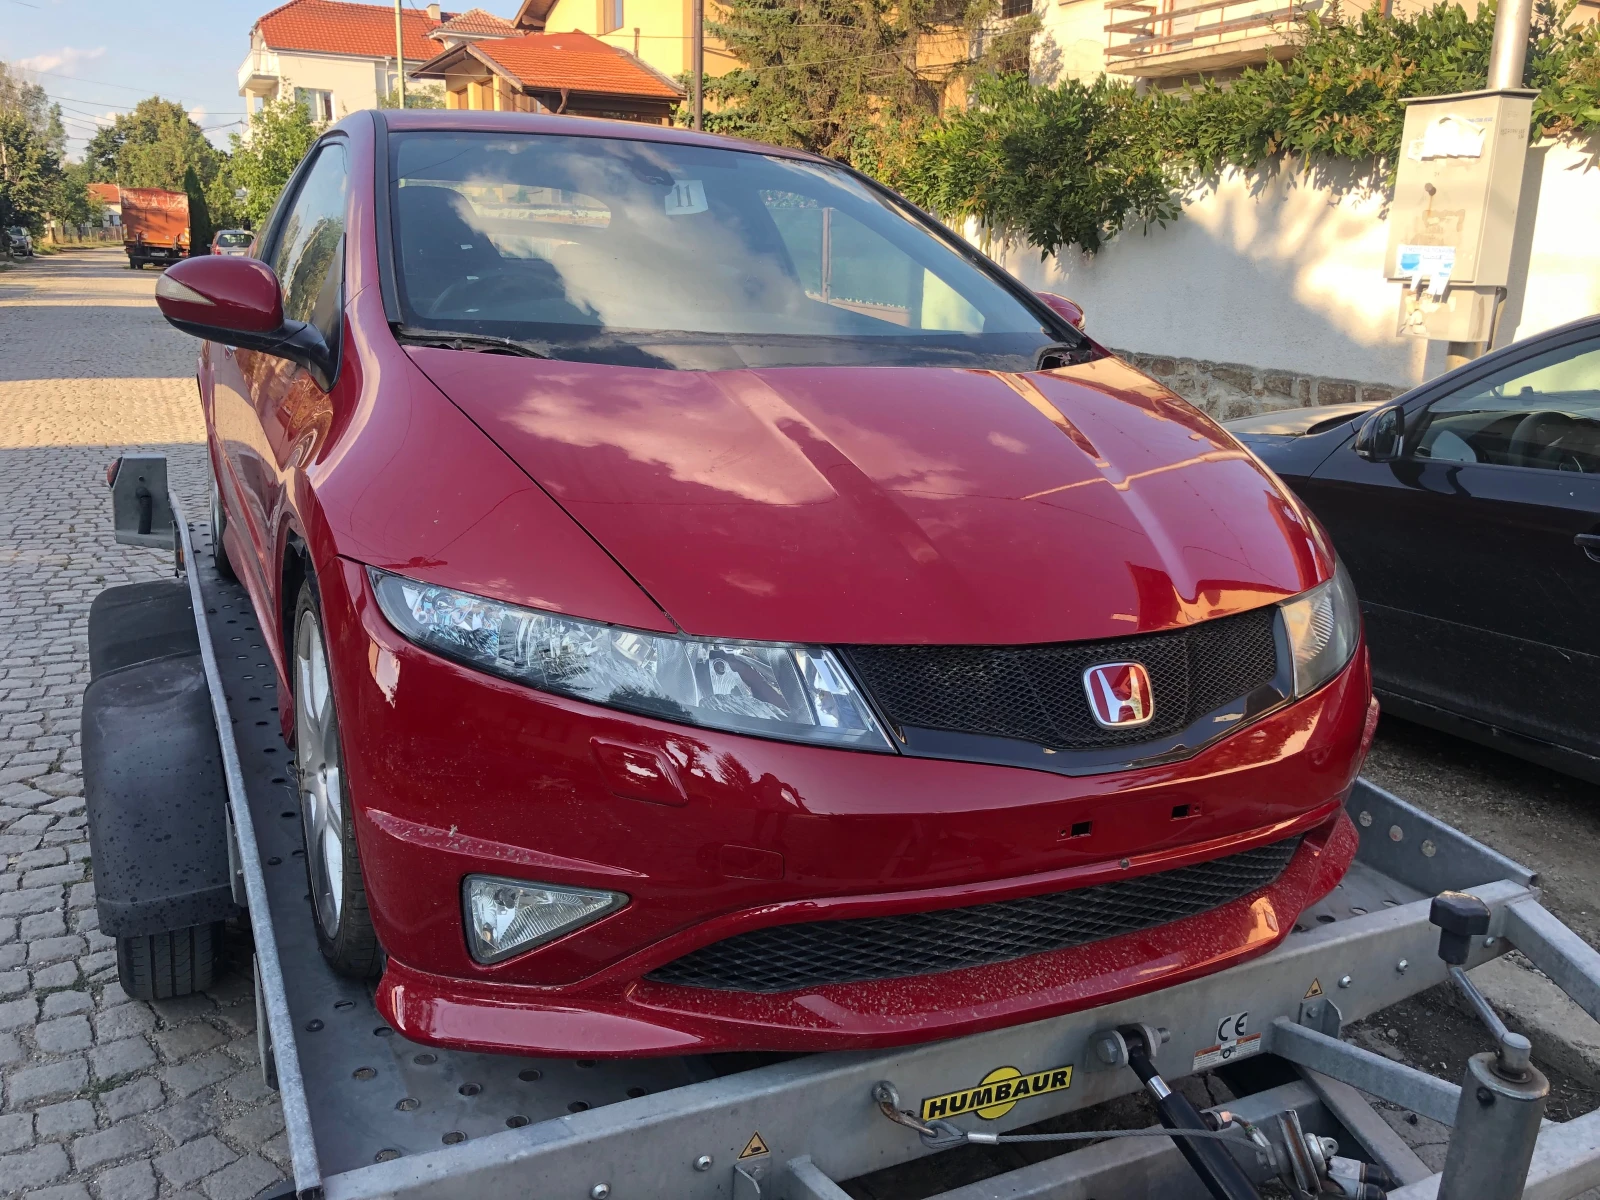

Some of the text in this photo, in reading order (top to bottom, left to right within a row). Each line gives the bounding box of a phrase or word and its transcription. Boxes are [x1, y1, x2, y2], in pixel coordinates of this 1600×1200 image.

[673, 184, 694, 208] 11
[1217, 1012, 1248, 1042] CE
[928, 1070, 1068, 1118] HUMBAUR
